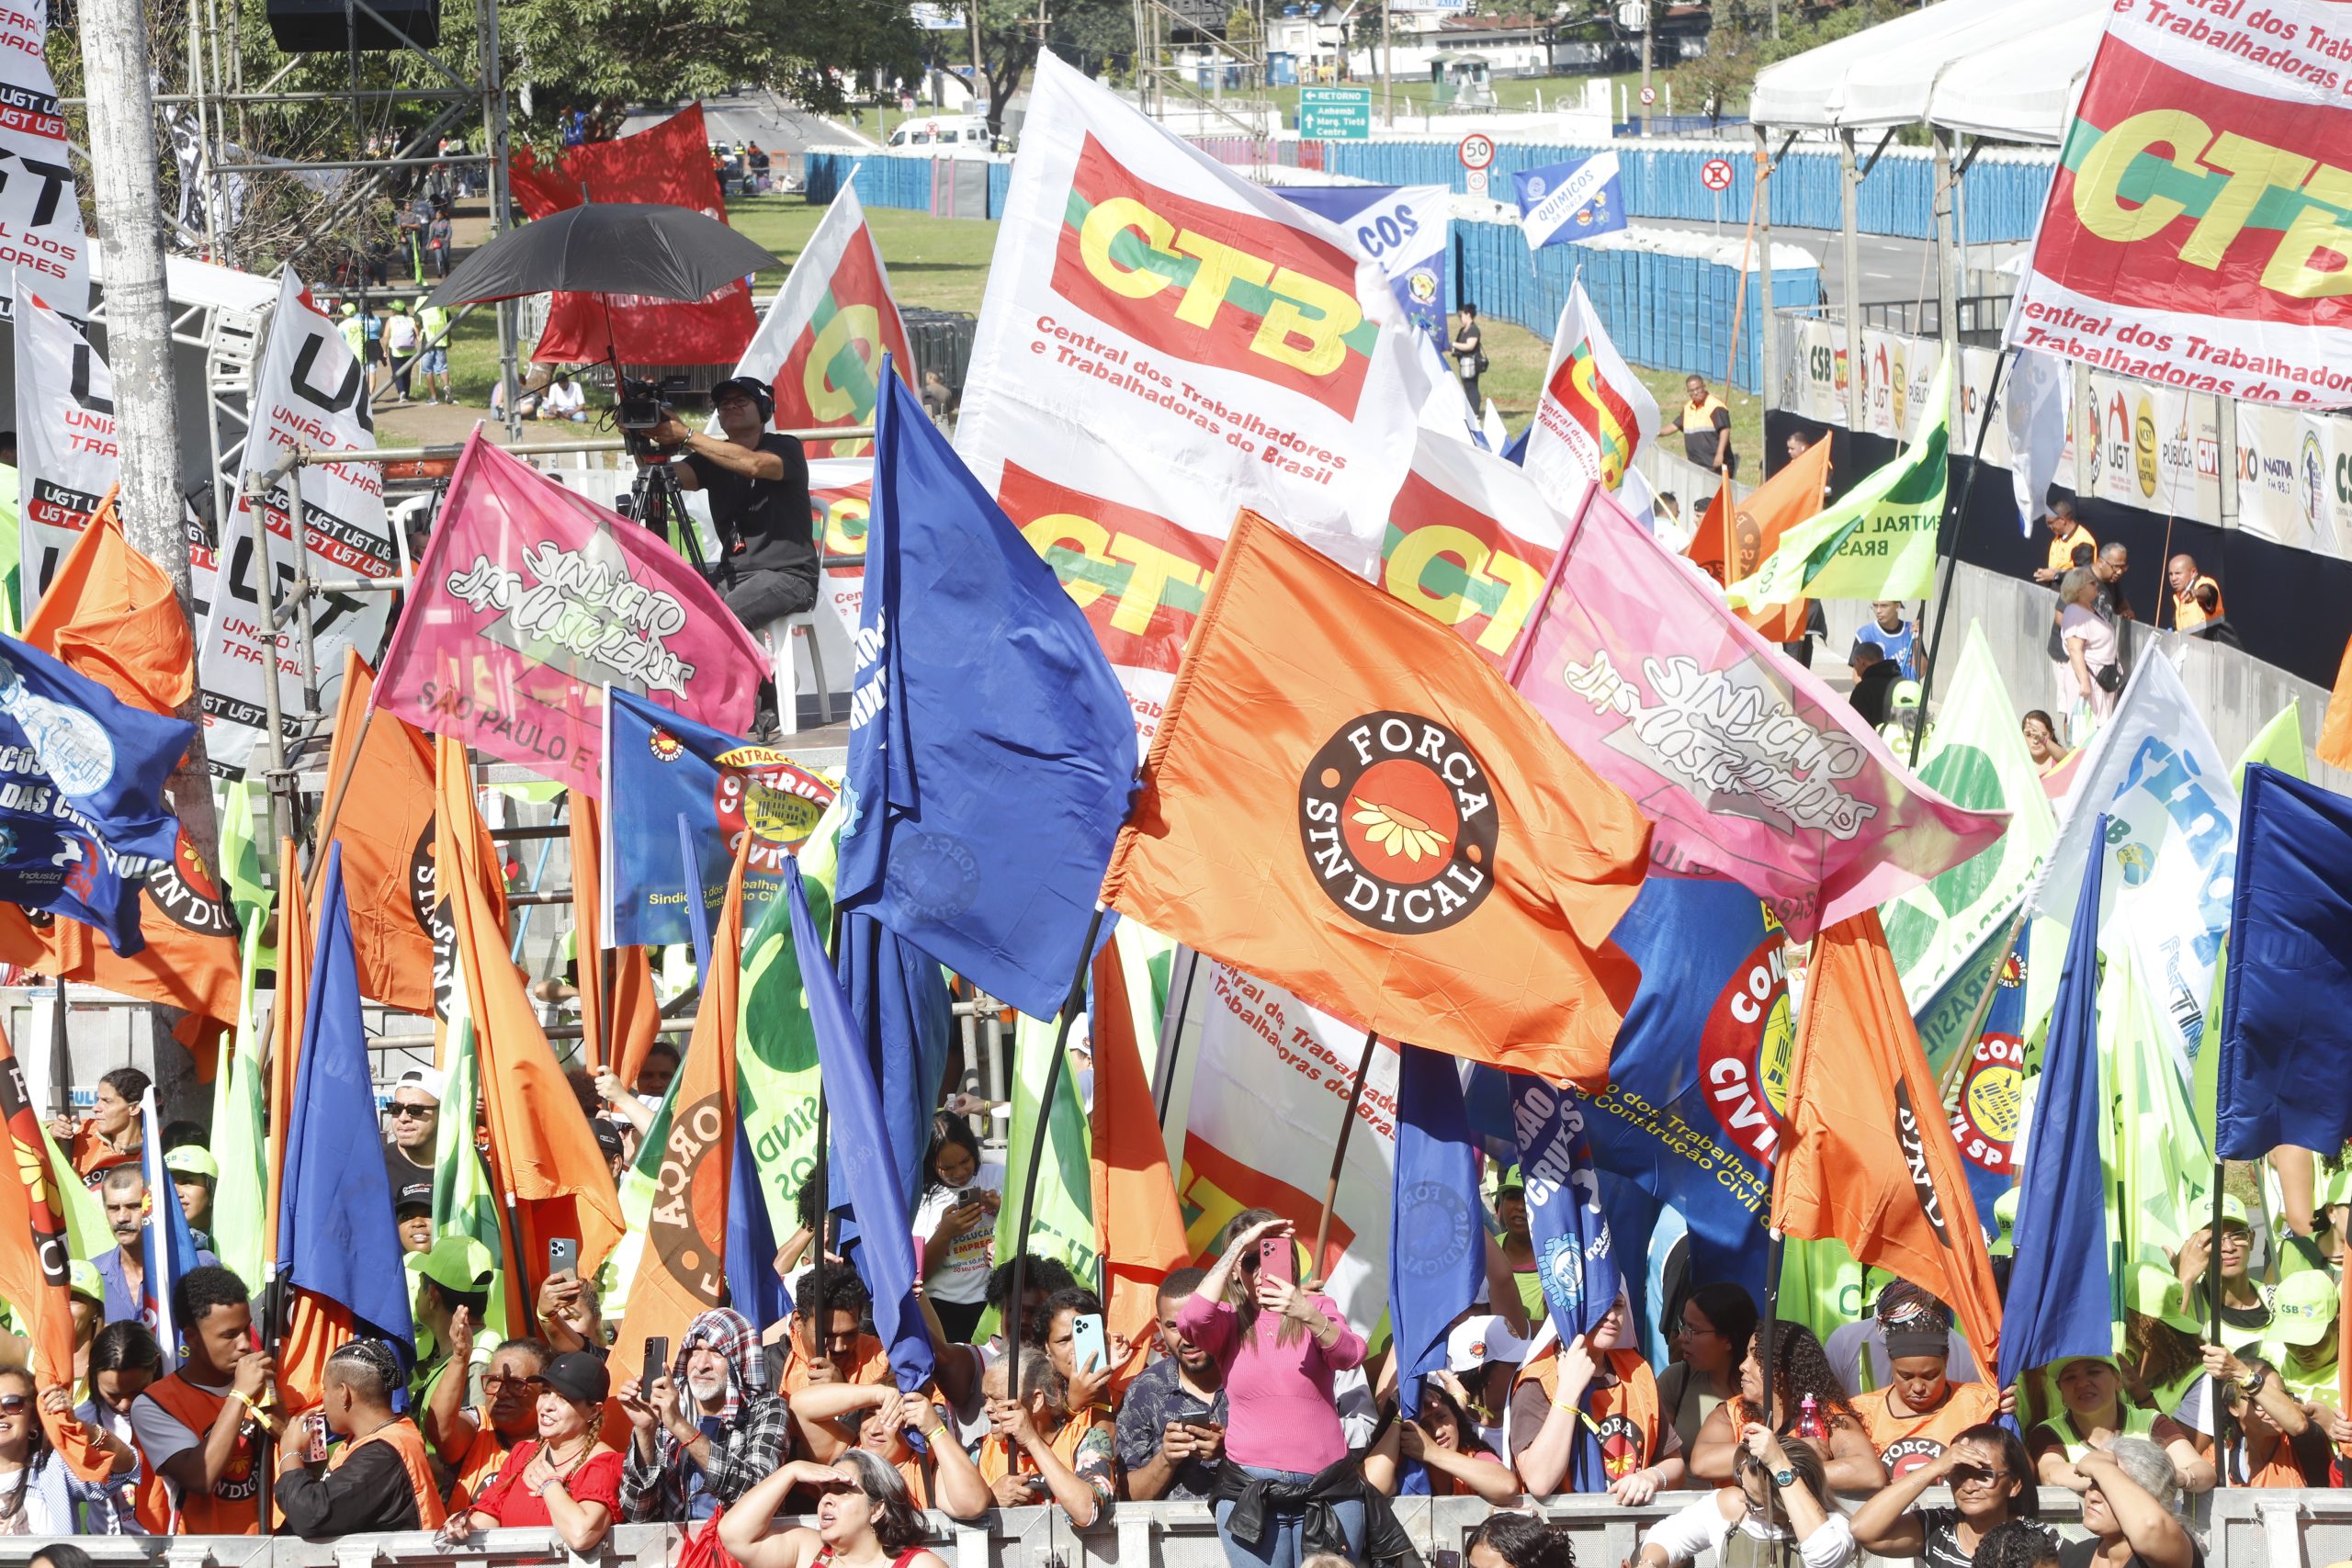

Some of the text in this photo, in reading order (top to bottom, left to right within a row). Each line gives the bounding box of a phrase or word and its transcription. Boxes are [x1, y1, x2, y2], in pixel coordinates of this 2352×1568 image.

[2246, 9, 2298, 40] dos
[2144, 0, 2339, 95] Trabalhadoras
[1317, 107, 1355, 116] Anhembi
[1318, 92, 1362, 101] RETORNO
[1317, 117, 1366, 127] Marg. Tietê
[1317, 128, 1347, 136] Centro
[1466, 141, 1488, 157] 50
[2074, 109, 2352, 299] CTB
[1358, 204, 1419, 258] COS
[23, 232, 77, 261] DOS
[1080, 197, 1363, 377] CTB
[2116, 322, 2173, 354] dos
[1810, 344, 1832, 382] CSB
[1035, 315, 1348, 470] Central dos Trabalhadores
[1873, 386, 1889, 408] UGT
[272, 404, 336, 446] UNIÃO
[1030, 340, 1335, 487] e Trabalhadoras do Brasil
[1538, 397, 1573, 429] Central
[1570, 427, 1587, 449] dos
[2140, 428, 2152, 442] NCST
[2109, 441, 2130, 474] UGT
[2263, 456, 2294, 480] NATIVA
[45, 486, 83, 511] UGT
[2267, 479, 2277, 490] FM
[39, 505, 71, 526] UGT
[305, 509, 344, 536] UGT
[343, 528, 375, 553] UGT
[333, 545, 364, 567] UGT
[1021, 513, 1216, 651] CT
[228, 698, 266, 724] UGT
[478, 705, 568, 761] PAULO
[569, 747, 594, 775] E
[650, 744, 684, 762] SINDICAL
[1347, 718, 1488, 821] FORÇA
[0, 783, 51, 814] DAS
[1306, 797, 1485, 923] SINDICAL
[708, 886, 723, 897] dos
[2010, 952, 2029, 980] FORÇA
[1323, 1074, 1351, 1100] do
[1623, 1088, 1661, 1119] dos
[1513, 1087, 1555, 1151] SÃO
[1594, 1093, 1714, 1171] Construção
[1716, 1169, 1762, 1213] Civil
[1966, 1139, 2003, 1167] SP
[2281, 1303, 2300, 1314] CSB
[1882, 1440, 1941, 1467] FORÇA
